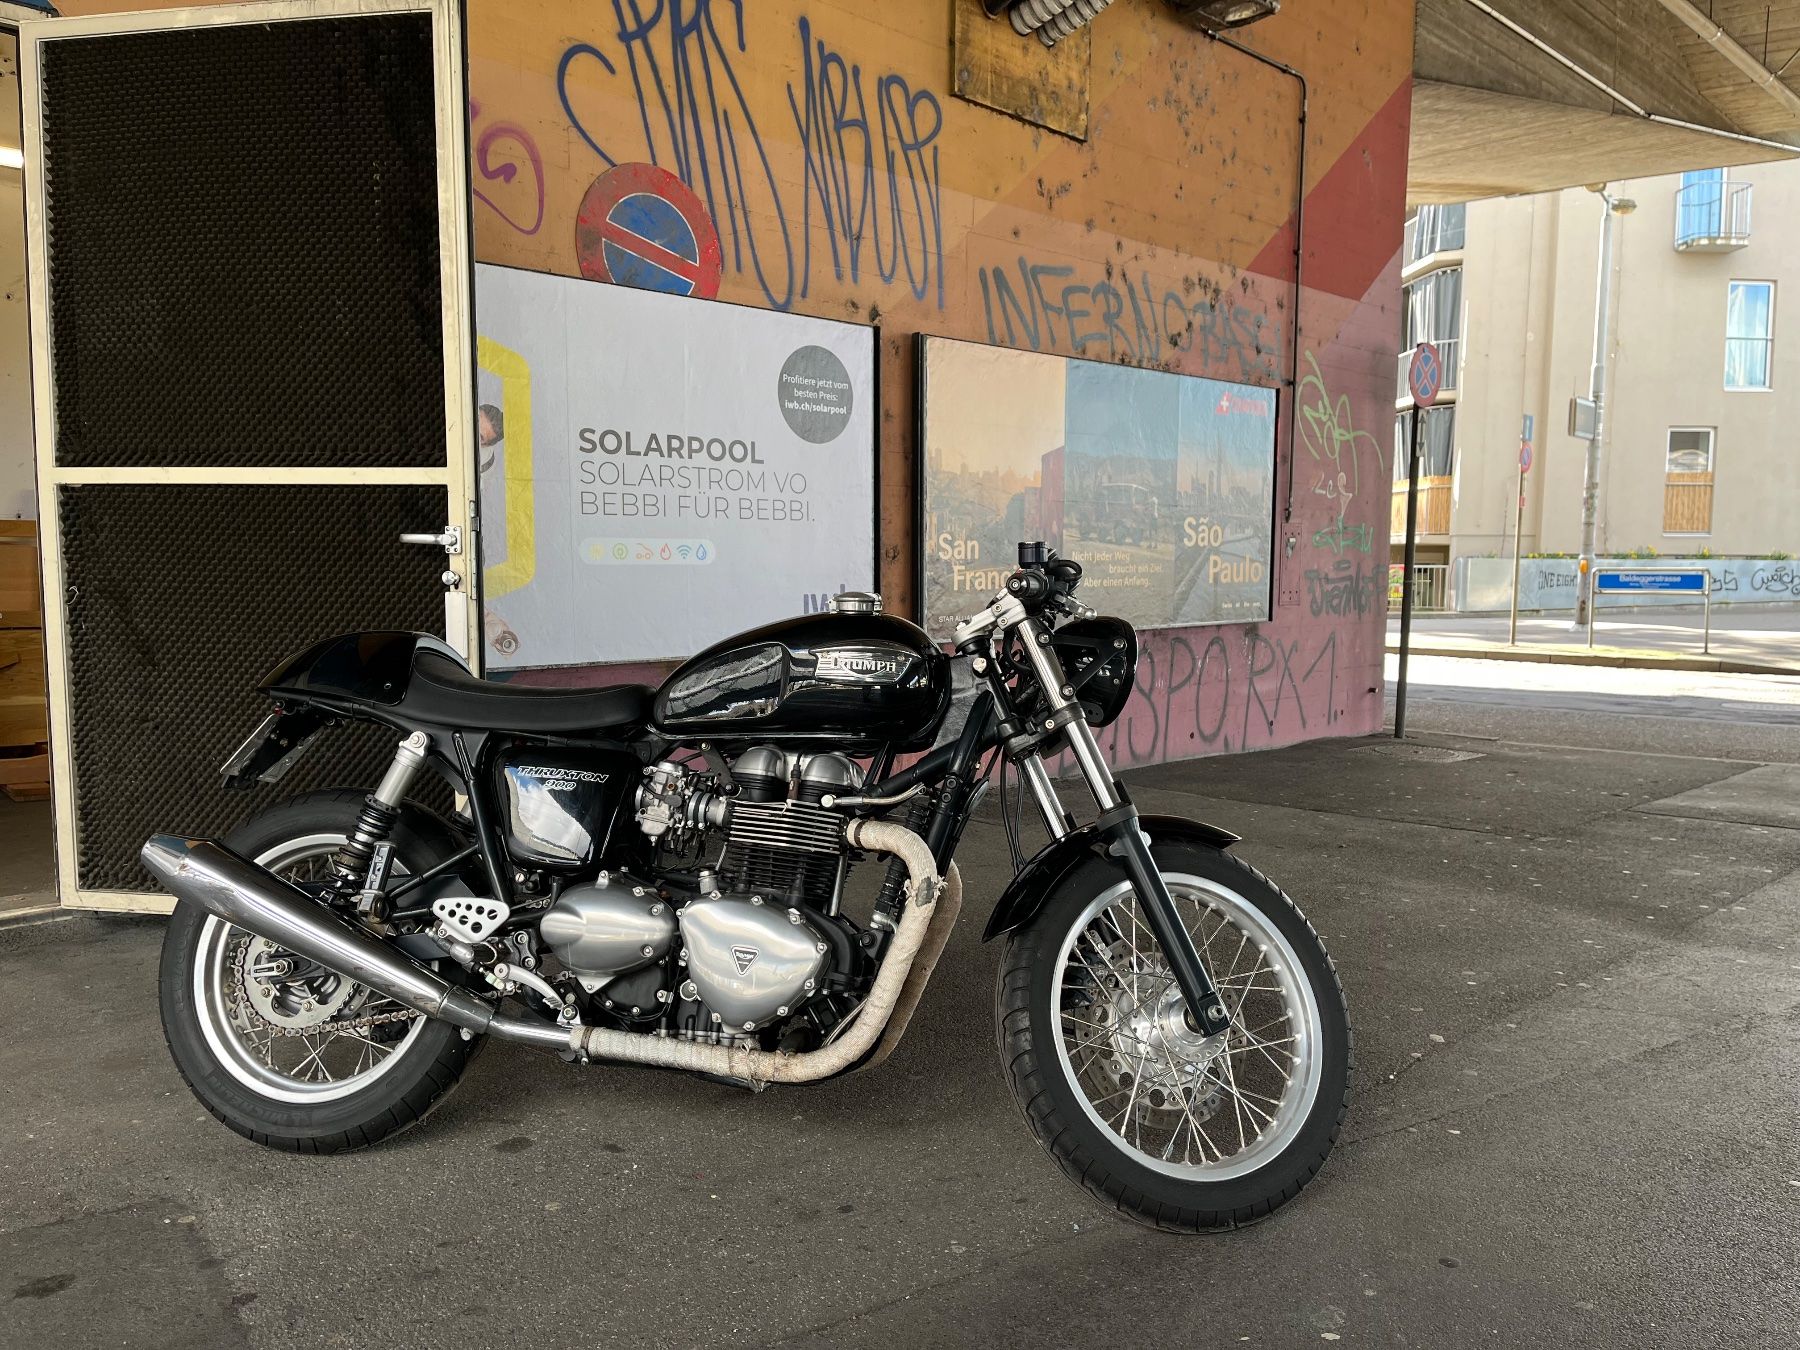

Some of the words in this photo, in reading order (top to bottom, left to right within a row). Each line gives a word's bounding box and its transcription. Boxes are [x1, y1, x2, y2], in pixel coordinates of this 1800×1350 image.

[782, 374, 816, 386] Profitiere
[816, 378, 833, 389] jetzt
[833, 382, 849, 390] vom
[794, 387, 818, 399] besten
[819, 391, 839, 401] Preis:
[785, 399, 847, 415] iwb.ch/solarpool
[578, 427, 765, 465] SOLARPOOL
[580, 460, 765, 493] SOLARSTROM
[773, 471, 807, 494] VO
[580, 491, 666, 517] BEBBI
[678, 491, 729, 519] FÜR
[739, 497, 815, 522] BEBBI.
[1183, 516, 1222, 547] São
[938, 532, 979, 560] San
[1071, 551, 1093, 561] Nicht
[1114, 551, 1130, 563] Weg
[1208, 554, 1263, 584] Paulo
[1083, 577, 1101, 587] Aber
[1103, 576, 1123, 587] einen
[831, 654, 897, 673] TRIUMPH
[518, 765, 609, 783] THRUXTON
[544, 779, 577, 791] 900
